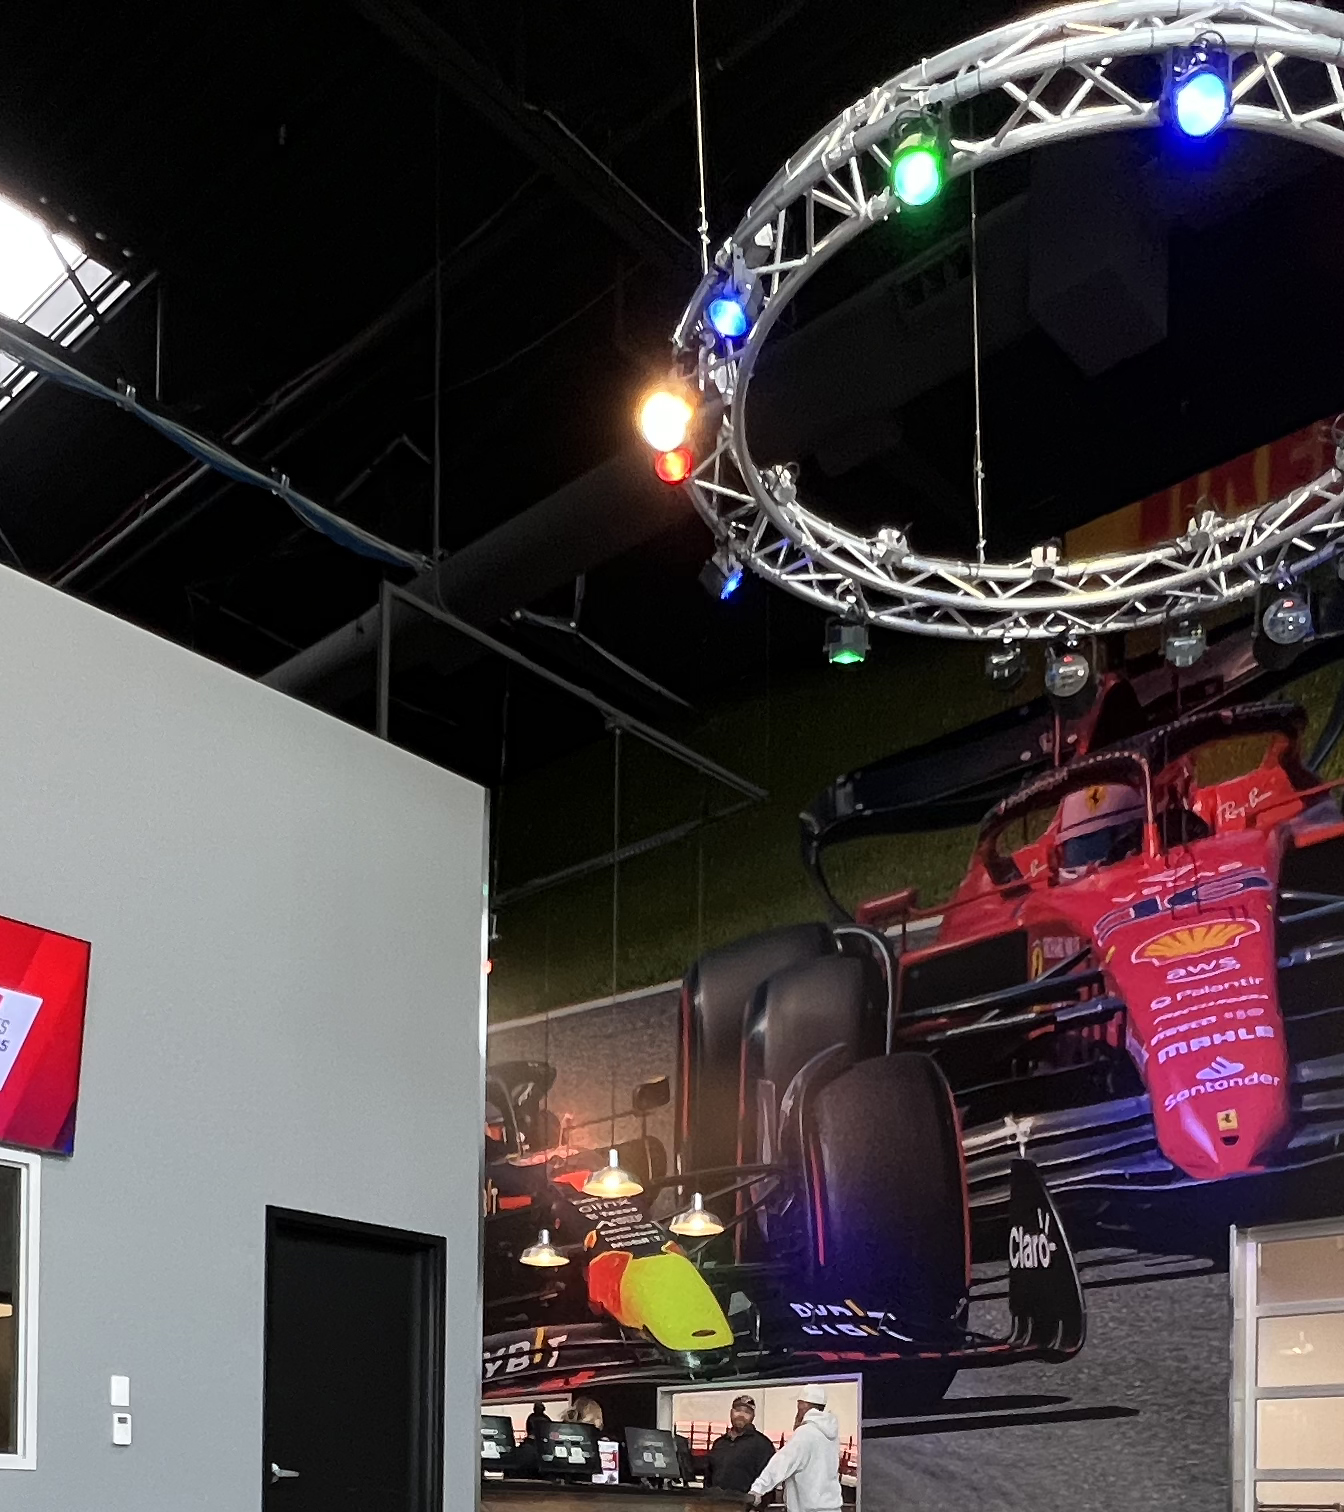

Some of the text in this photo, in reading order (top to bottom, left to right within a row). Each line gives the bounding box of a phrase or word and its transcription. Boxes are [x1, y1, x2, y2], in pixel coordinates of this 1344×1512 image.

[1166, 956, 1241, 984] aws
[1157, 1025, 1275, 1065] MAHLE
[1009, 1226, 1051, 1269] Claro
